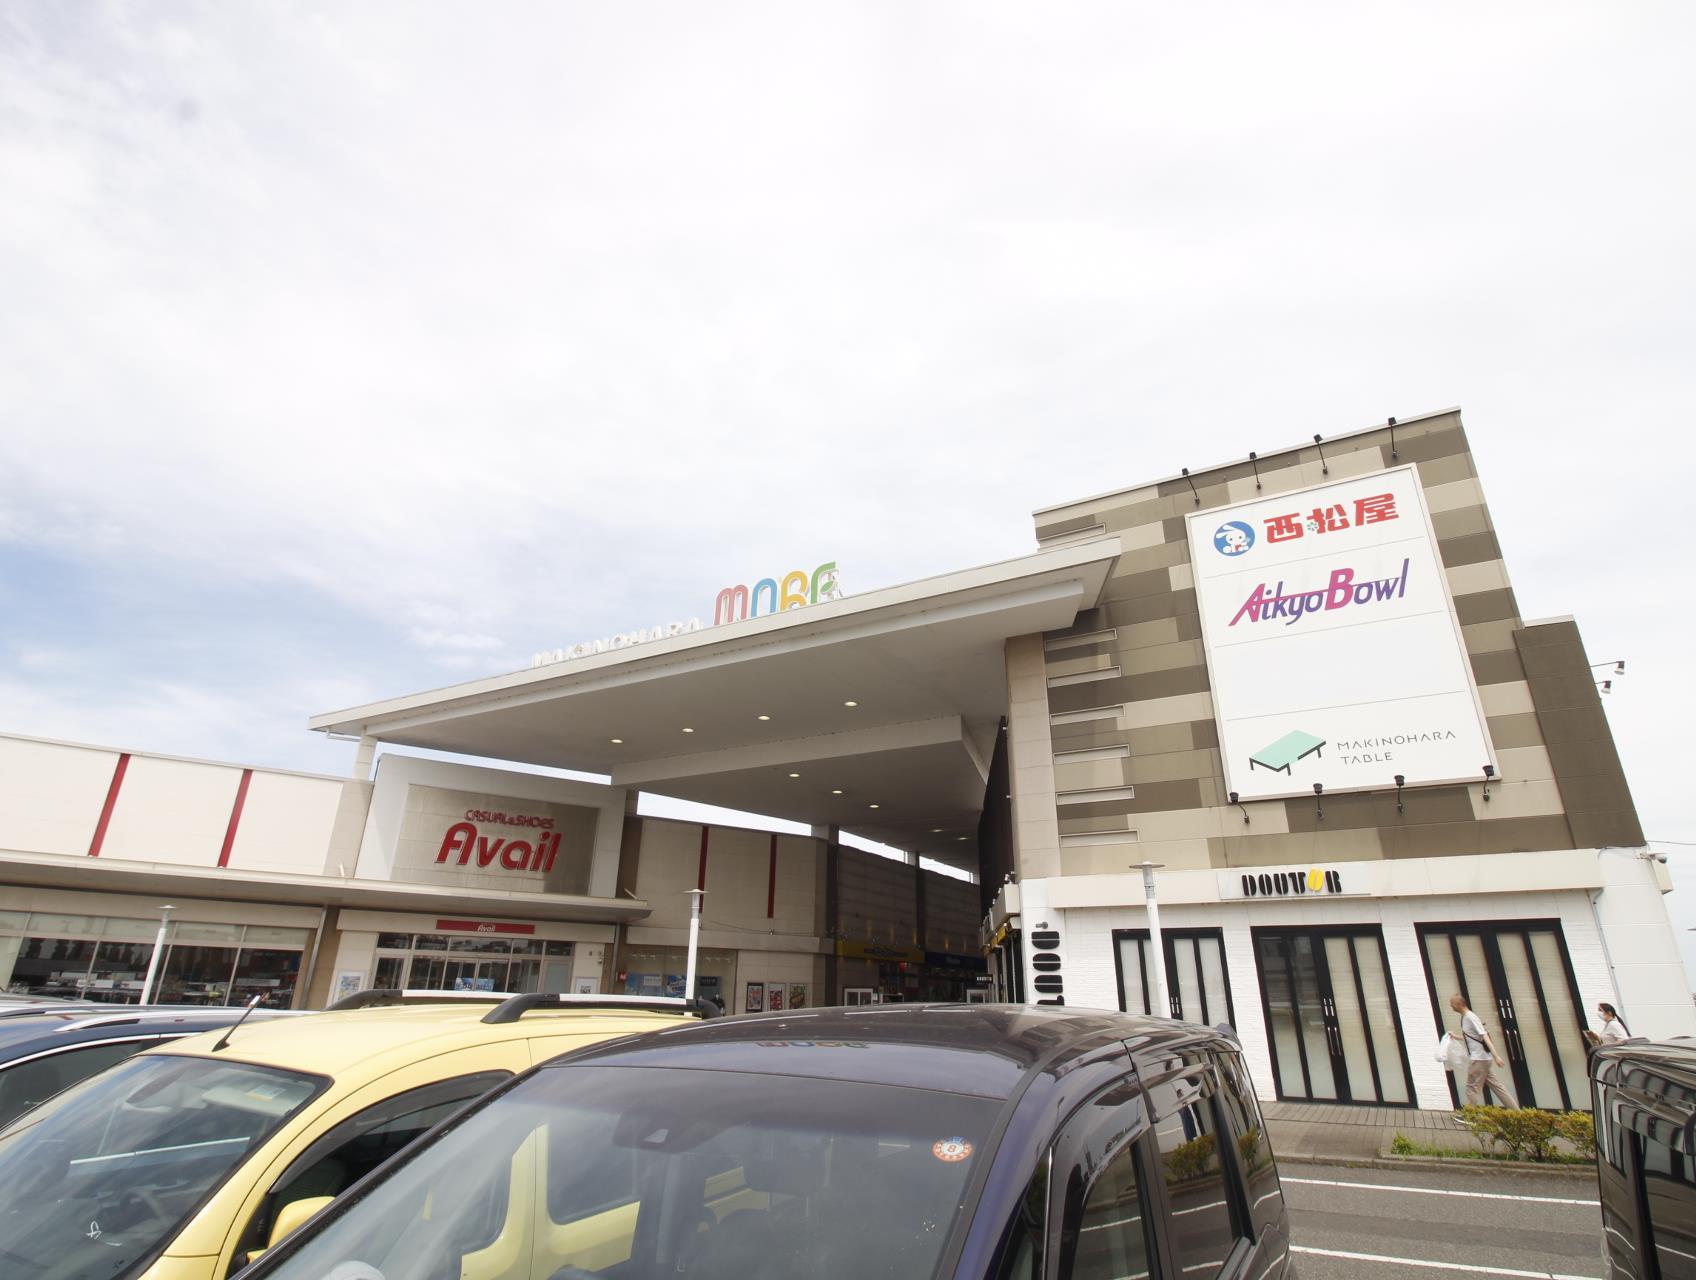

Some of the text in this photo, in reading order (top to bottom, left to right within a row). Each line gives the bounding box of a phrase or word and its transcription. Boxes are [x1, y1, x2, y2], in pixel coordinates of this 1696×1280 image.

[1263, 493, 1399, 543] 西松屋
[1337, 731, 1456, 750] MAKINOHARA
[1340, 752, 1392, 765] TABLE
[434, 822, 562, 873] Avail
[1241, 868, 1342, 896] DOUTOR
